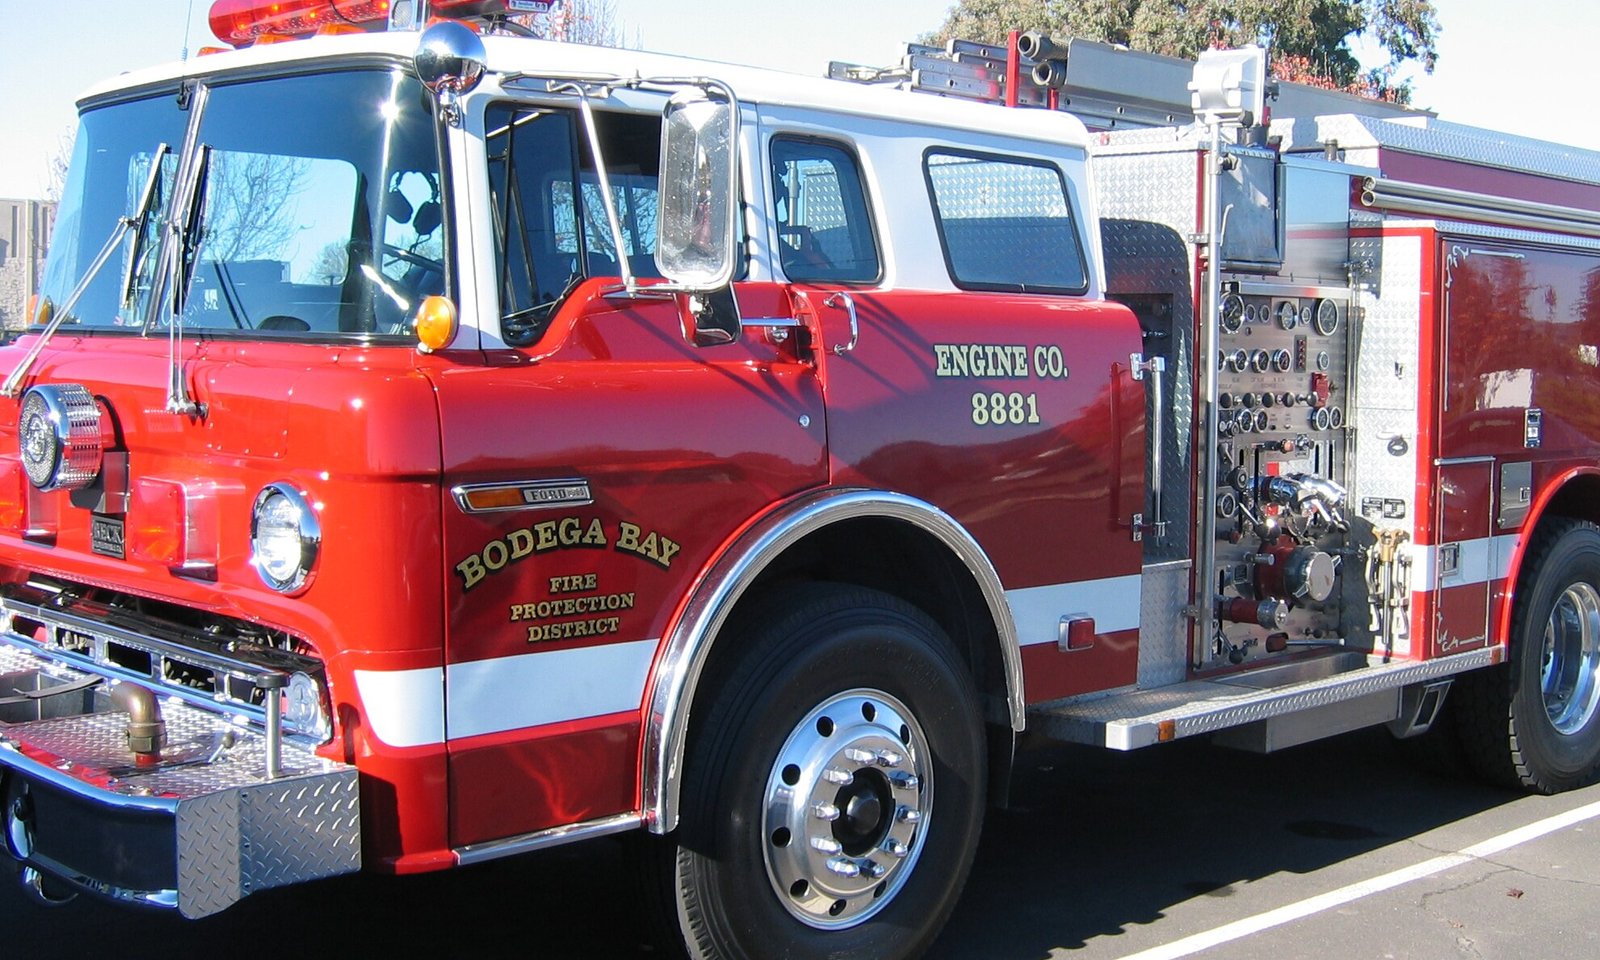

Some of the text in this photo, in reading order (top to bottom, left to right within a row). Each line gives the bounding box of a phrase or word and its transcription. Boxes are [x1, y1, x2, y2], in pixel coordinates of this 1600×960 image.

[934, 344, 1069, 378] ENGINE CO.
[971, 392, 1040, 425] 8881
[530, 488, 567, 501] FORD
[456, 517, 681, 589] BODEGA BAY
[549, 573, 598, 593] FIRE
[510, 592, 636, 621] PROTECTION
[527, 616, 620, 643] DISTRICT
